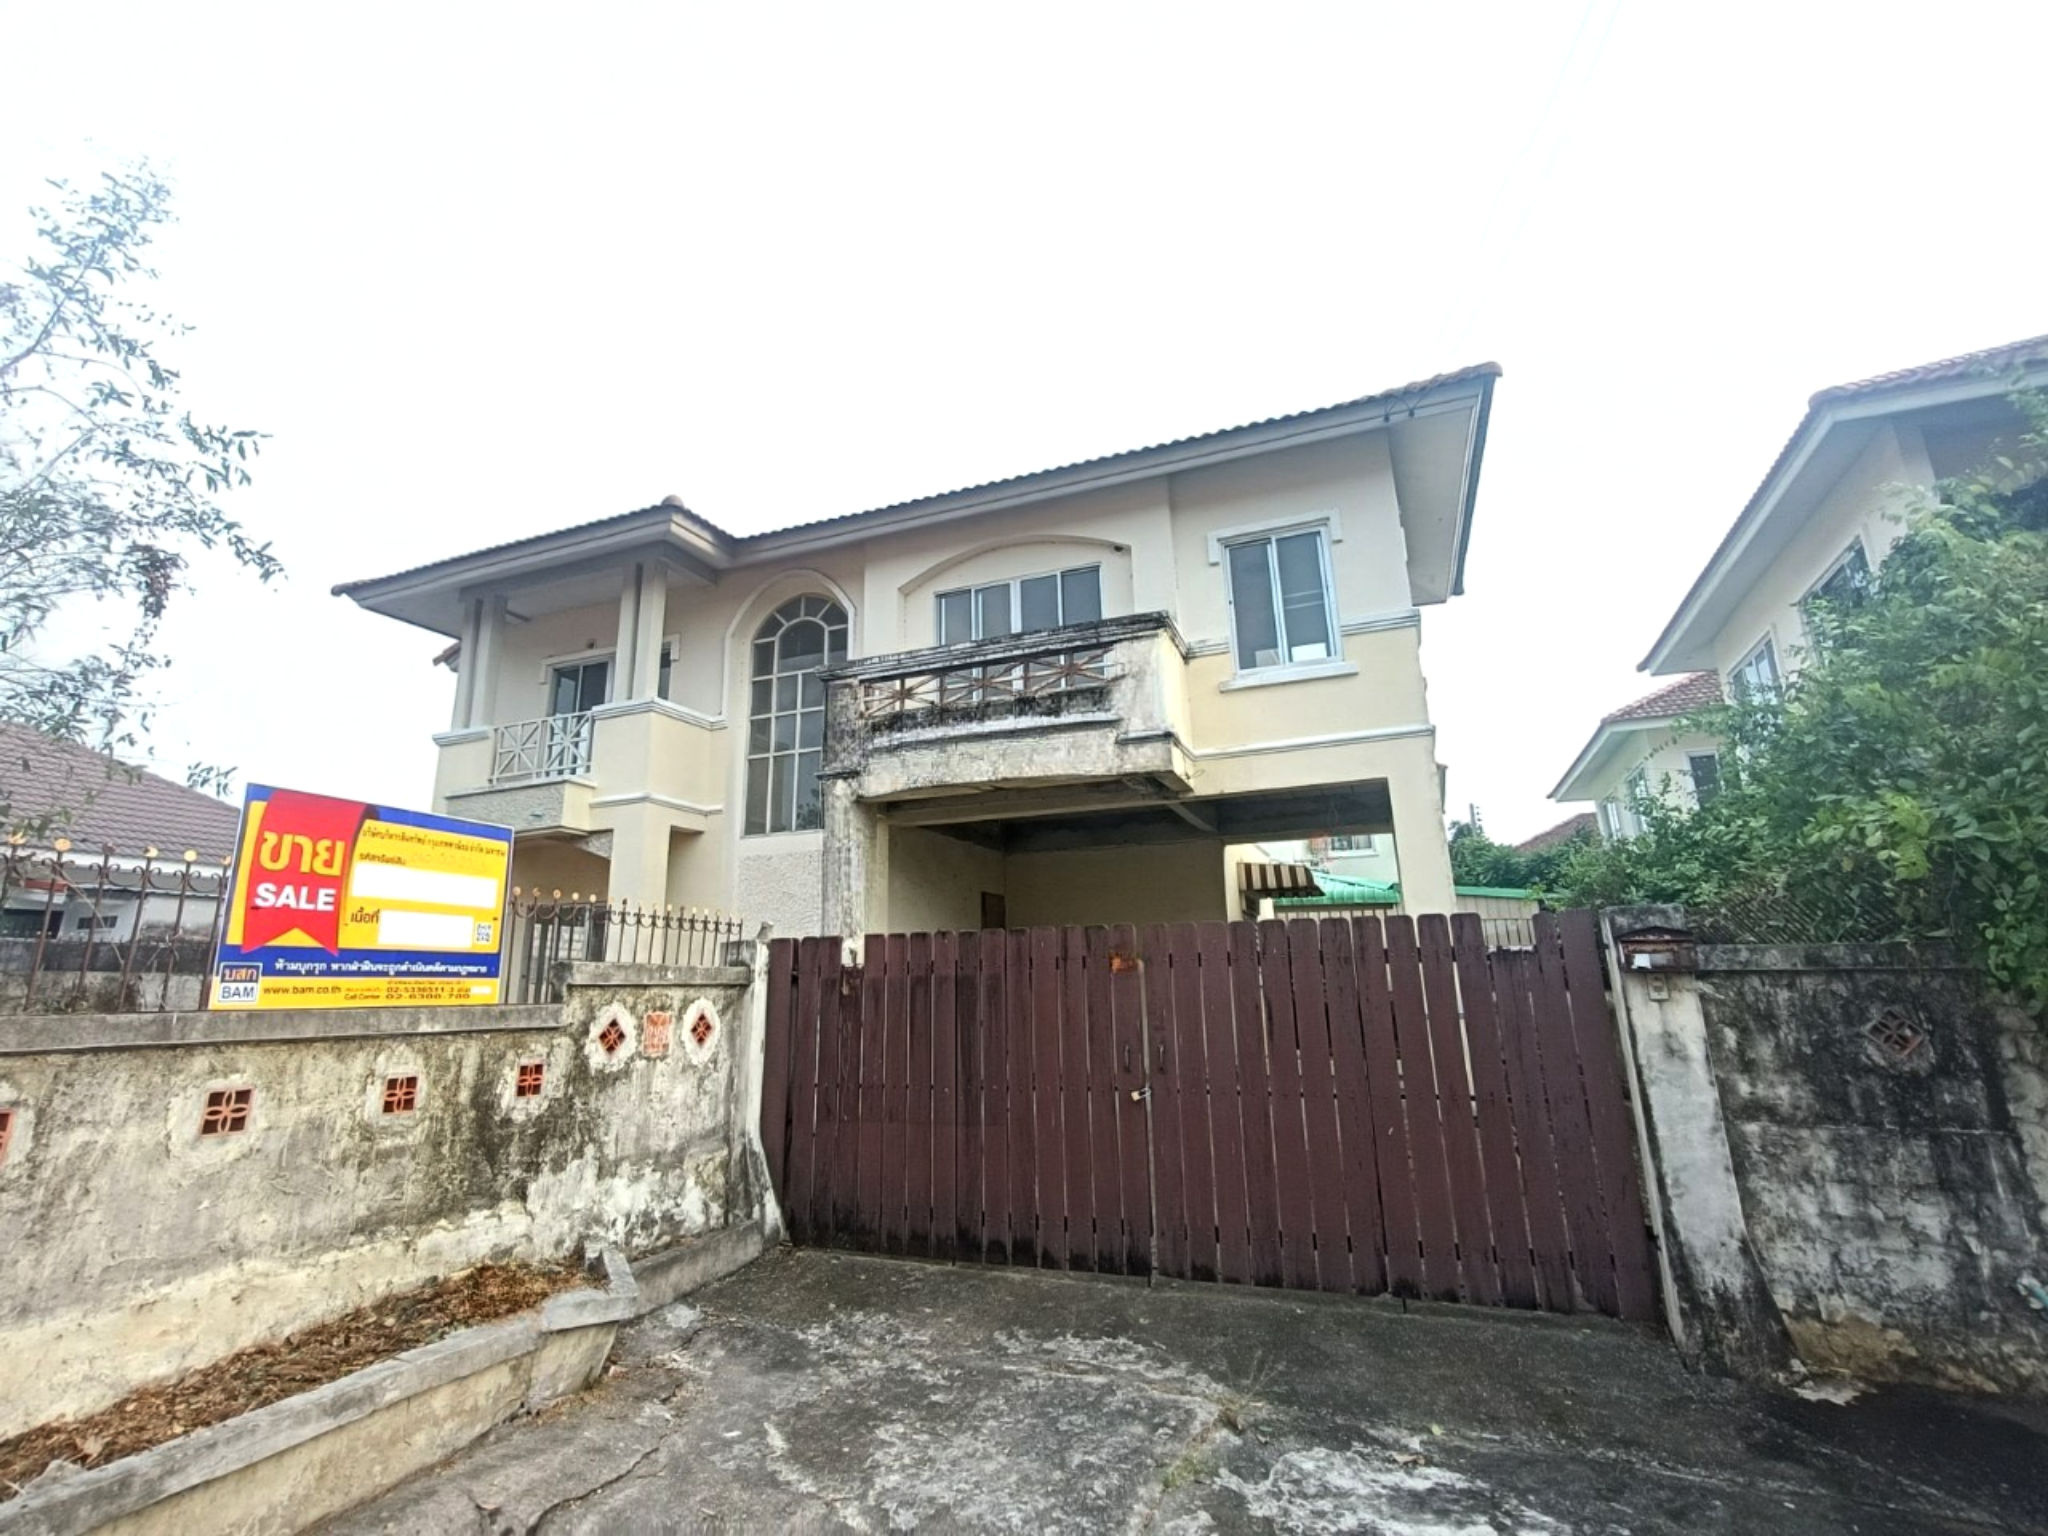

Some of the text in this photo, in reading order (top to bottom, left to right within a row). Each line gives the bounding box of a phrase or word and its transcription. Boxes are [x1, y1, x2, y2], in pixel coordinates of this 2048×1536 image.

[259, 830, 345, 877] ขาย
[254, 882, 337, 912] SALE
[350, 906, 381, 924] เนื้อที่
[223, 967, 257, 981] บสก
[275, 958, 327, 975] ห้ามบุกรุก
[221, 985, 255, 999] BAM
[263, 986, 342, 995] www.bam.co.th
